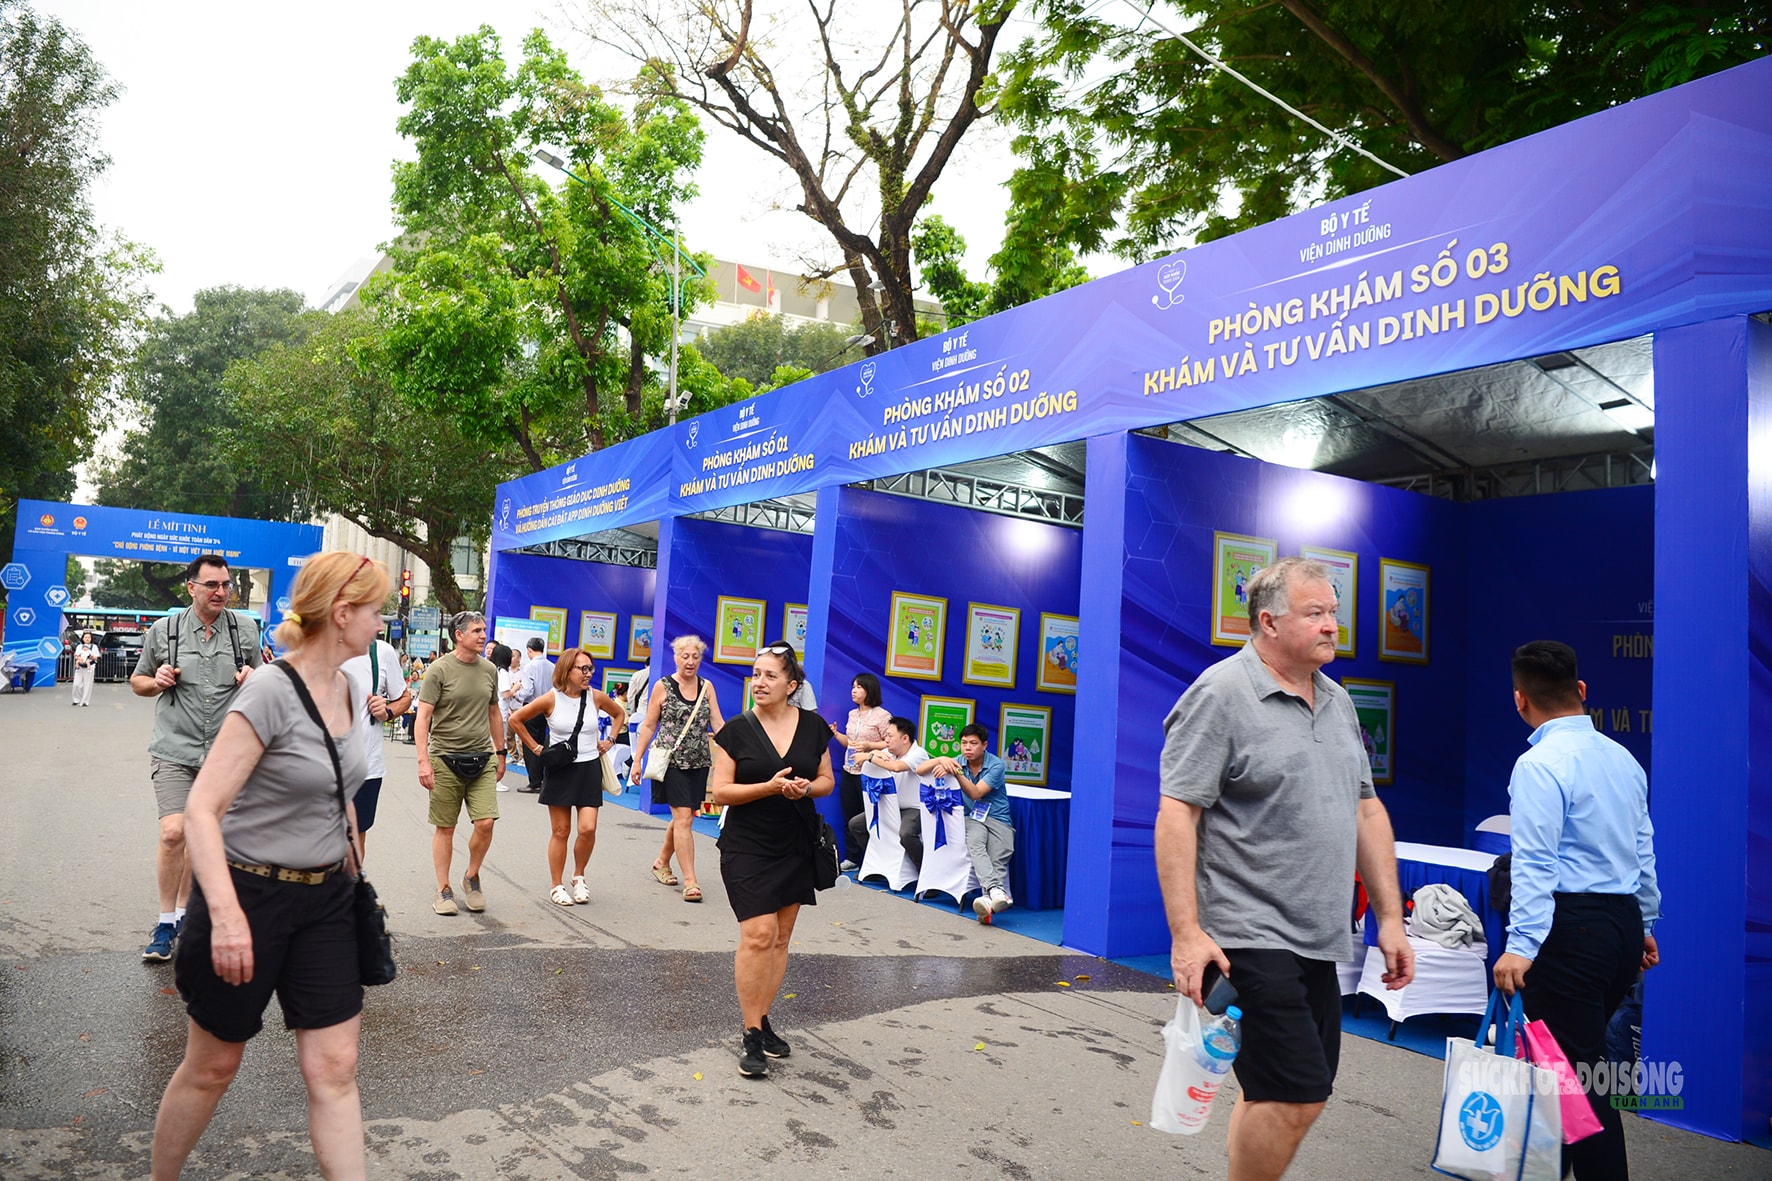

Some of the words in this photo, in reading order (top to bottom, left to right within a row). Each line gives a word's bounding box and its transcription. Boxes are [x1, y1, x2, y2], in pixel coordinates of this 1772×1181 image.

[1320, 212, 1337, 237] BỘ
[1341, 211, 1350, 230] Y
[1352, 198, 1372, 225] TẾ
[1300, 243, 1323, 263] VIỆN
[1326, 235, 1350, 256] DINH
[1354, 223, 1392, 248] DƯỠNG
[1208, 298, 1304, 344] PHÒNG
[1310, 270, 1403, 319] KHÁM
[1411, 238, 1458, 293] SỐ
[1466, 242, 1509, 279] 03
[942, 338, 952, 356] BỘ
[952, 337, 958, 350] Y
[958, 331, 969, 348] TẾ
[1144, 356, 1215, 396] KHÁM
[1220, 342, 1258, 379] VÀ
[1264, 336, 1302, 369] TƯ
[1305, 310, 1370, 360] VẤN
[1378, 298, 1465, 345] DINH
[1474, 264, 1620, 325] DƯỠNG
[884, 396, 932, 426] PHÒNG
[934, 381, 980, 412] KHÁM
[982, 364, 1008, 400] SỐ
[1009, 368, 1030, 393] 02
[849, 432, 887, 460] KHÁM
[889, 424, 908, 452] VÀ
[910, 422, 931, 446] TƯ
[931, 410, 962, 442] VẤN
[964, 406, 1008, 434] DINH
[1010, 390, 1078, 424] DƯỠNG
[702, 450, 732, 472] PHÒNG
[733, 441, 760, 465] KHÁM
[762, 430, 777, 457] SỐ
[778, 435, 788, 454] 01
[680, 477, 704, 498] KHÁM
[705, 472, 718, 492] VÀ
[718, 472, 732, 490] TƯ
[731, 462, 750, 486] VẤN
[750, 466, 776, 484] DINH
[777, 453, 814, 478] DƯỠNG
[568, 510, 579, 523] APP
[578, 506, 593, 521] DINH
[581, 490, 593, 506] DỤC
[593, 486, 608, 498] DINH
[148, 518, 160, 530] LỄ
[182, 522, 207, 533] TINH
[1612, 706, 1631, 732] VÀ
